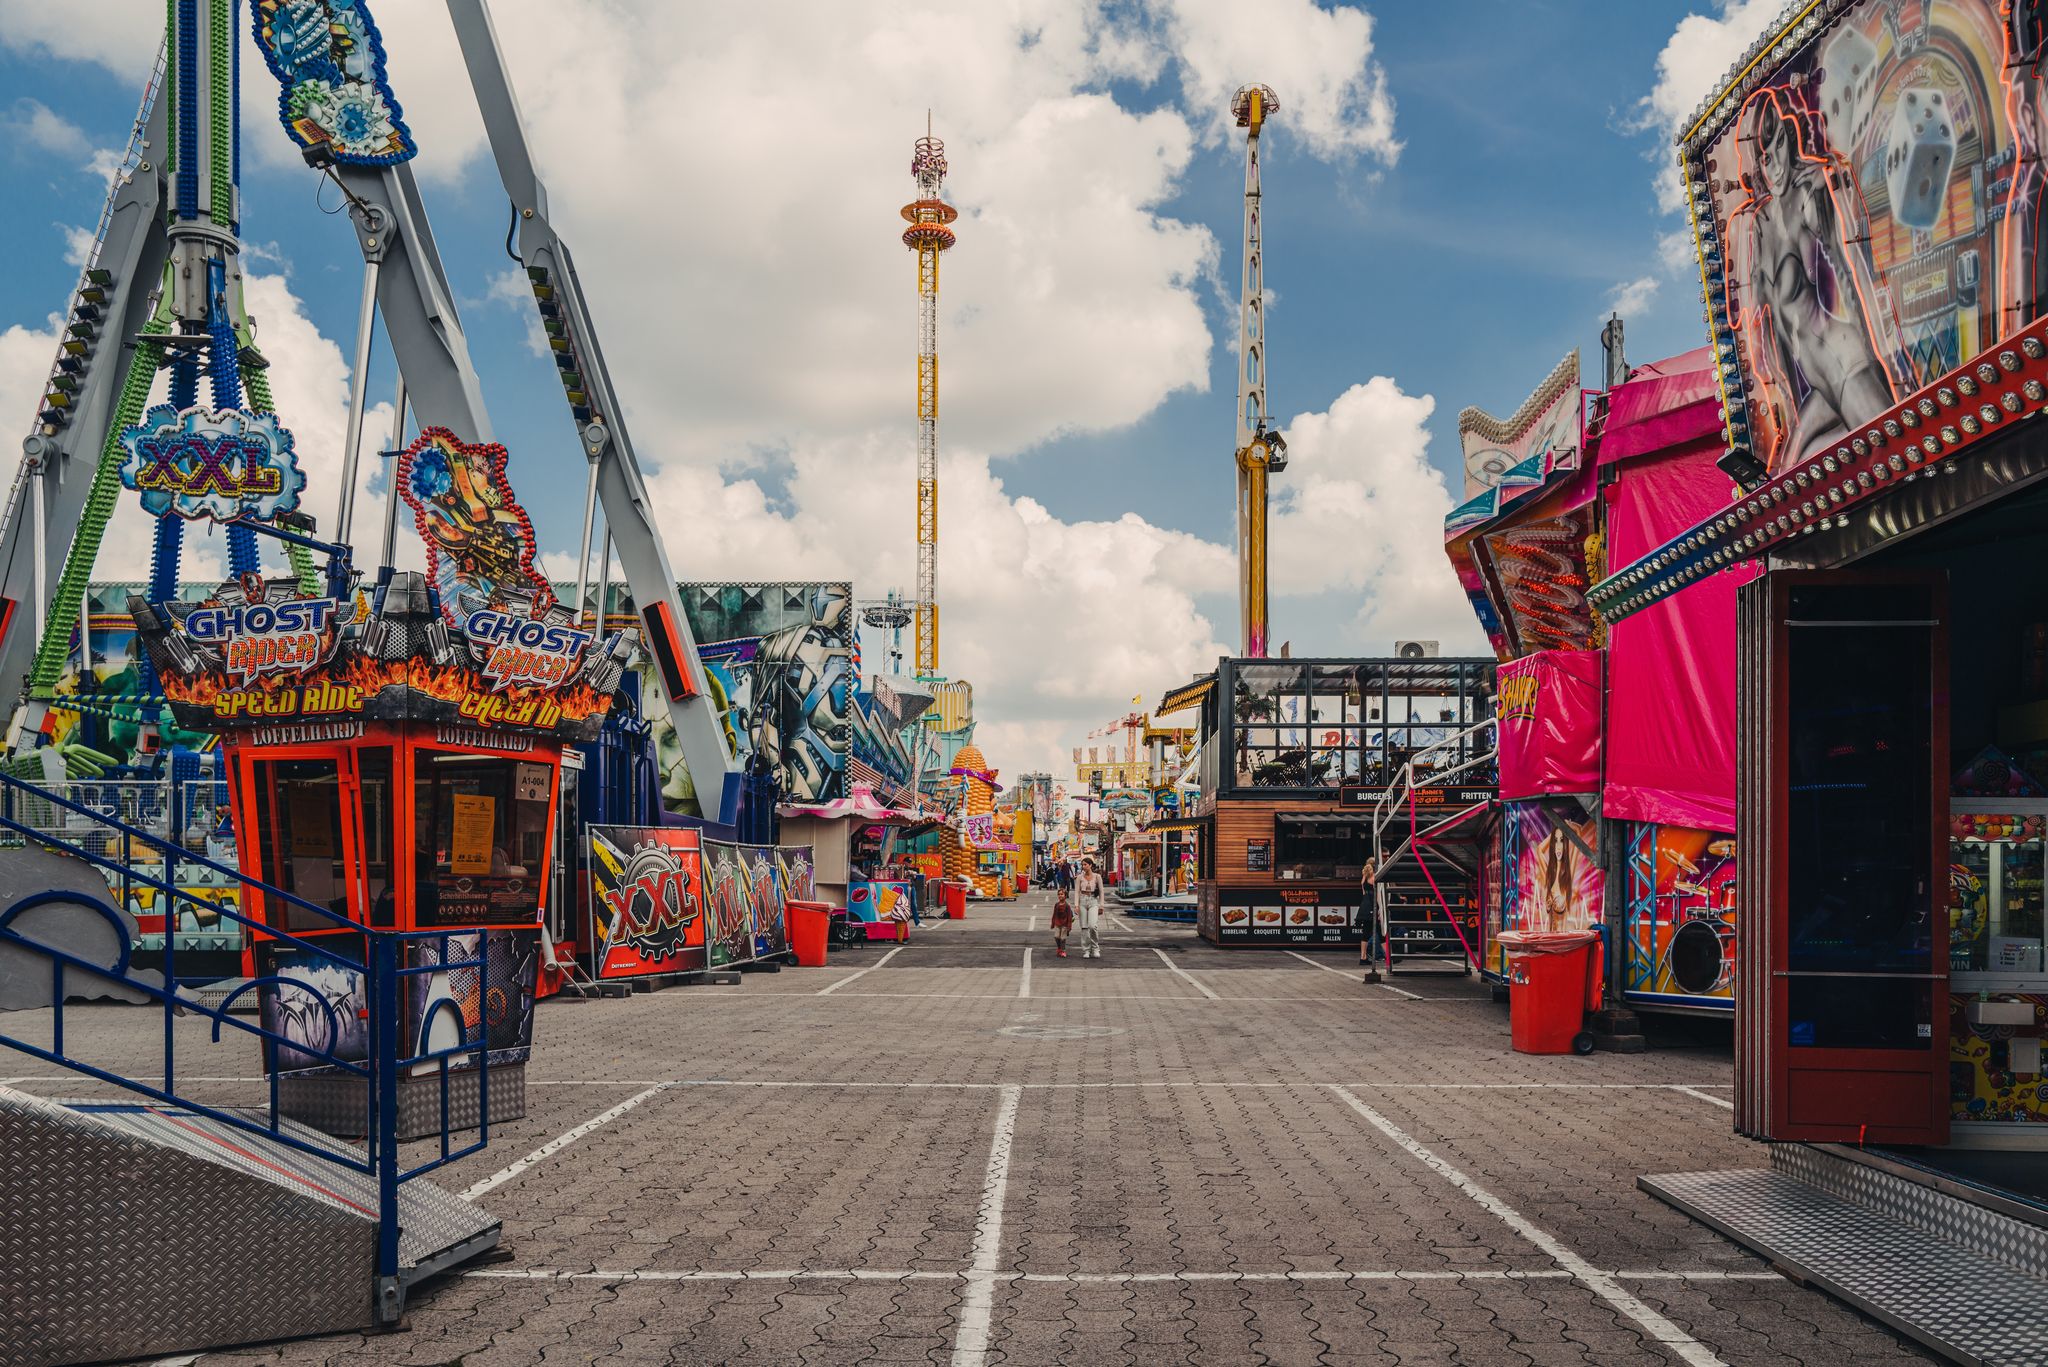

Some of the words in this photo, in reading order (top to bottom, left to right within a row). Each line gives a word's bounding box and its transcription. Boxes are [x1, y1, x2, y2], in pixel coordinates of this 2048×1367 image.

[137, 433, 282, 496] XXL
[186, 600, 336, 638] GHOST
[467, 609, 592, 656] GHOST
[229, 634, 317, 676] RIDER
[488, 648, 567, 683] RIDER
[215, 690, 298, 717] SPEED
[304, 681, 365, 714] RIDE
[460, 693, 537, 728] CHECK
[535, 698, 562, 729] IN
[251, 722, 368, 746] LÖFFELHARDT
[436, 725, 536, 752] LÖFFELHARDT
[521, 776, 545, 786] A1-004
[1461, 792, 1492, 800] FRITTEN
[968, 816, 990, 831] SOFT
[606, 868, 699, 943] XXL
[711, 874, 744, 945] XXL
